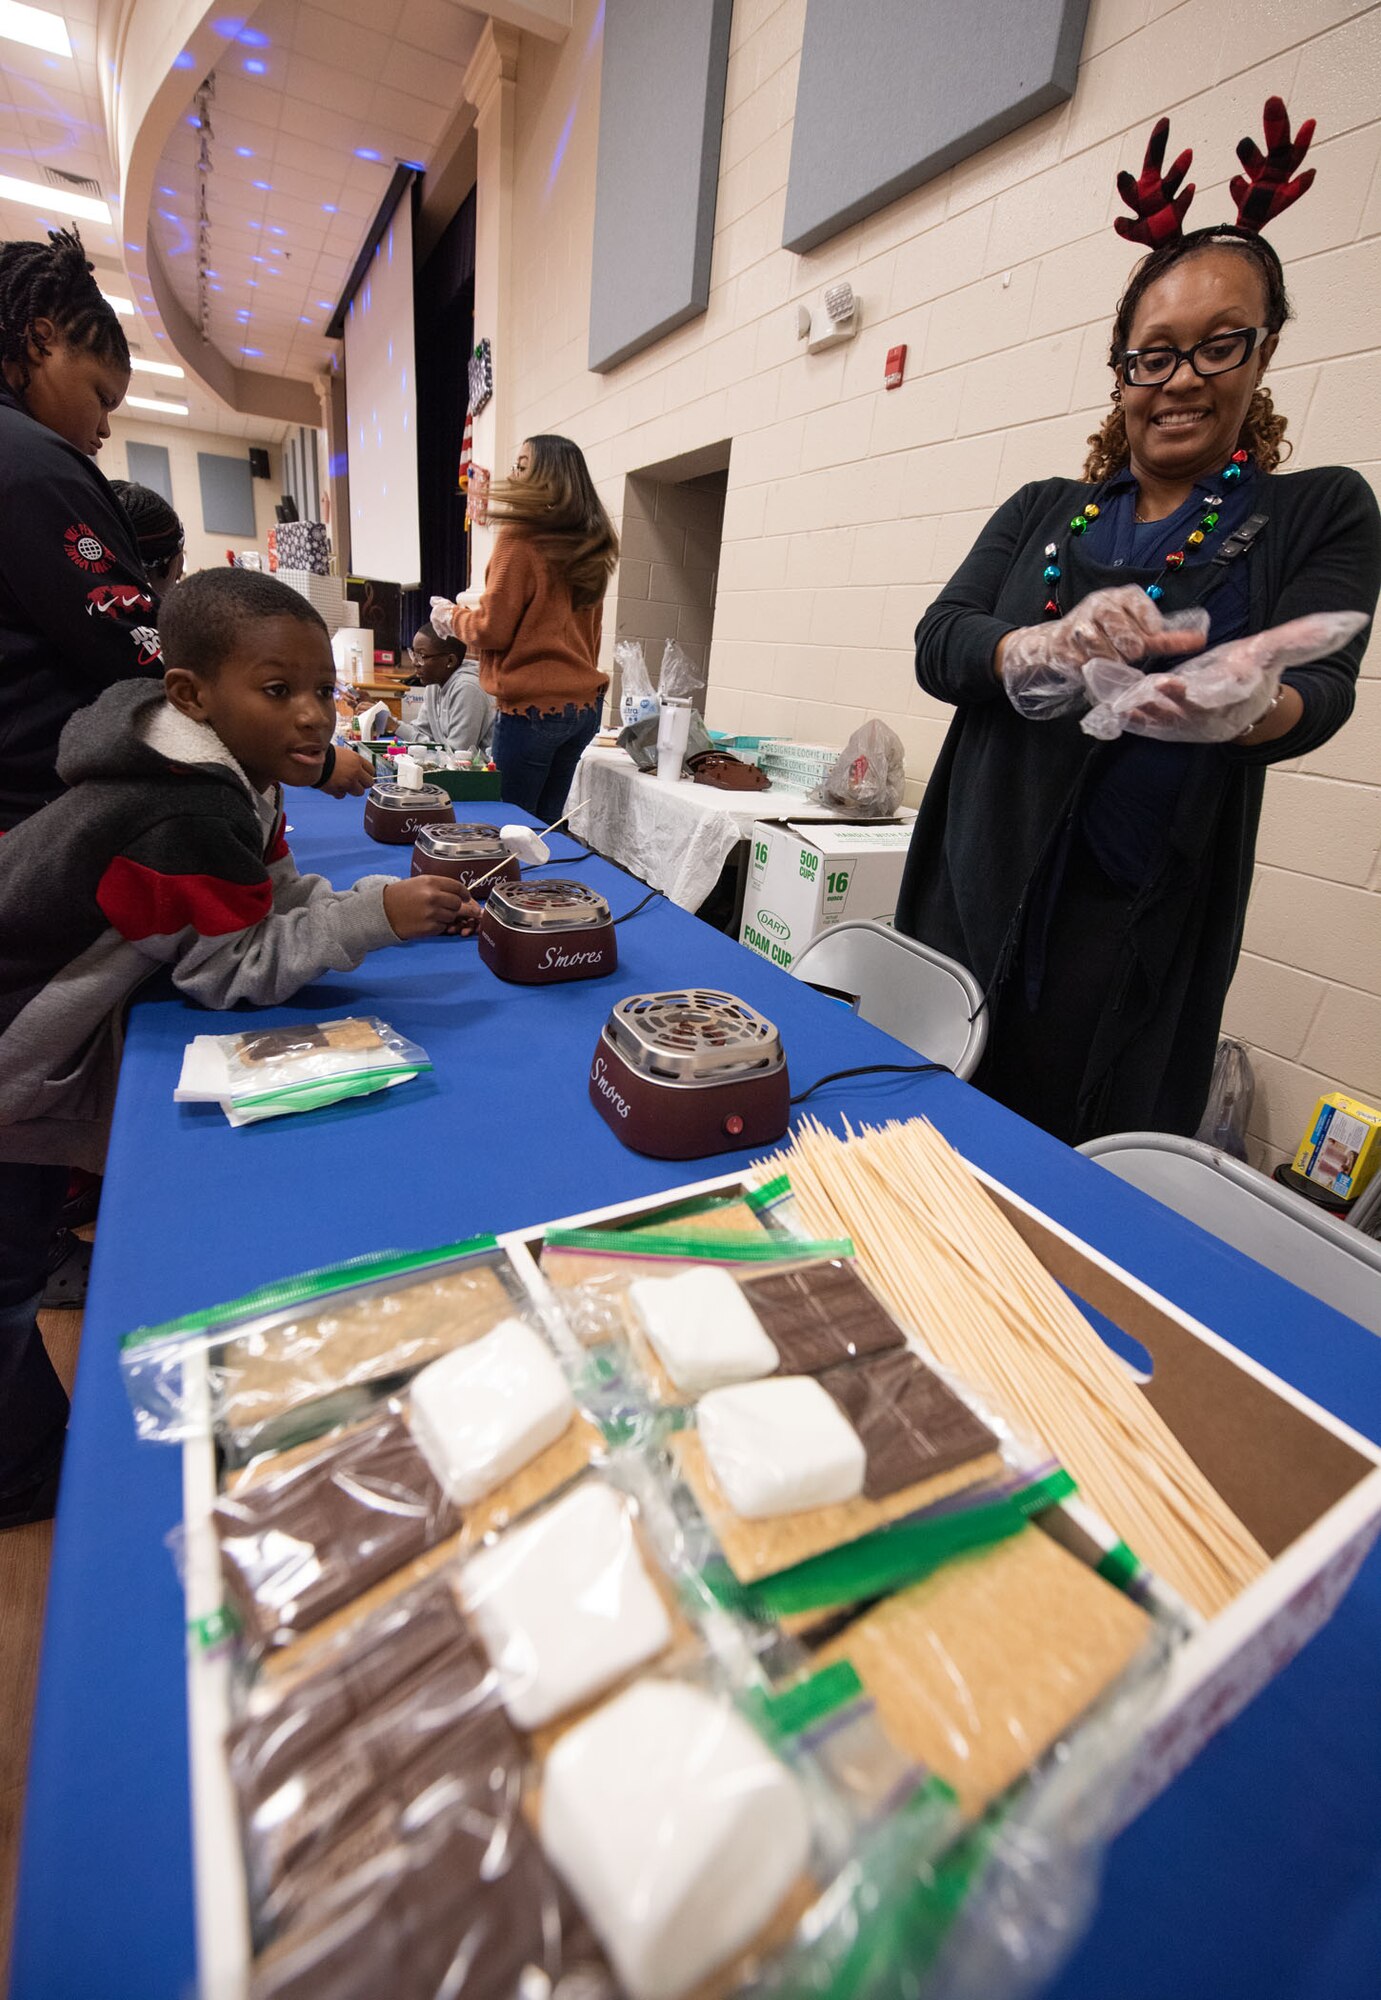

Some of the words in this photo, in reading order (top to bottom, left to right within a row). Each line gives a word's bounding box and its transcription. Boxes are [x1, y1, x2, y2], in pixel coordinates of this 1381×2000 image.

[766, 744, 795, 756] DESIGNER
[797, 748, 820, 759] COOKIE
[822, 752, 833, 761] KIT
[755, 841, 769, 864] 16
[800, 849, 819, 871] 500
[799, 868, 816, 882] CUPS
[827, 872, 849, 894] 16
[760, 913, 787, 936] DART
[744, 924, 770, 955] FOAM
[771, 943, 794, 968] CUP
[538, 947, 603, 970] S'mores
[590, 1057, 632, 1119] S'mores
